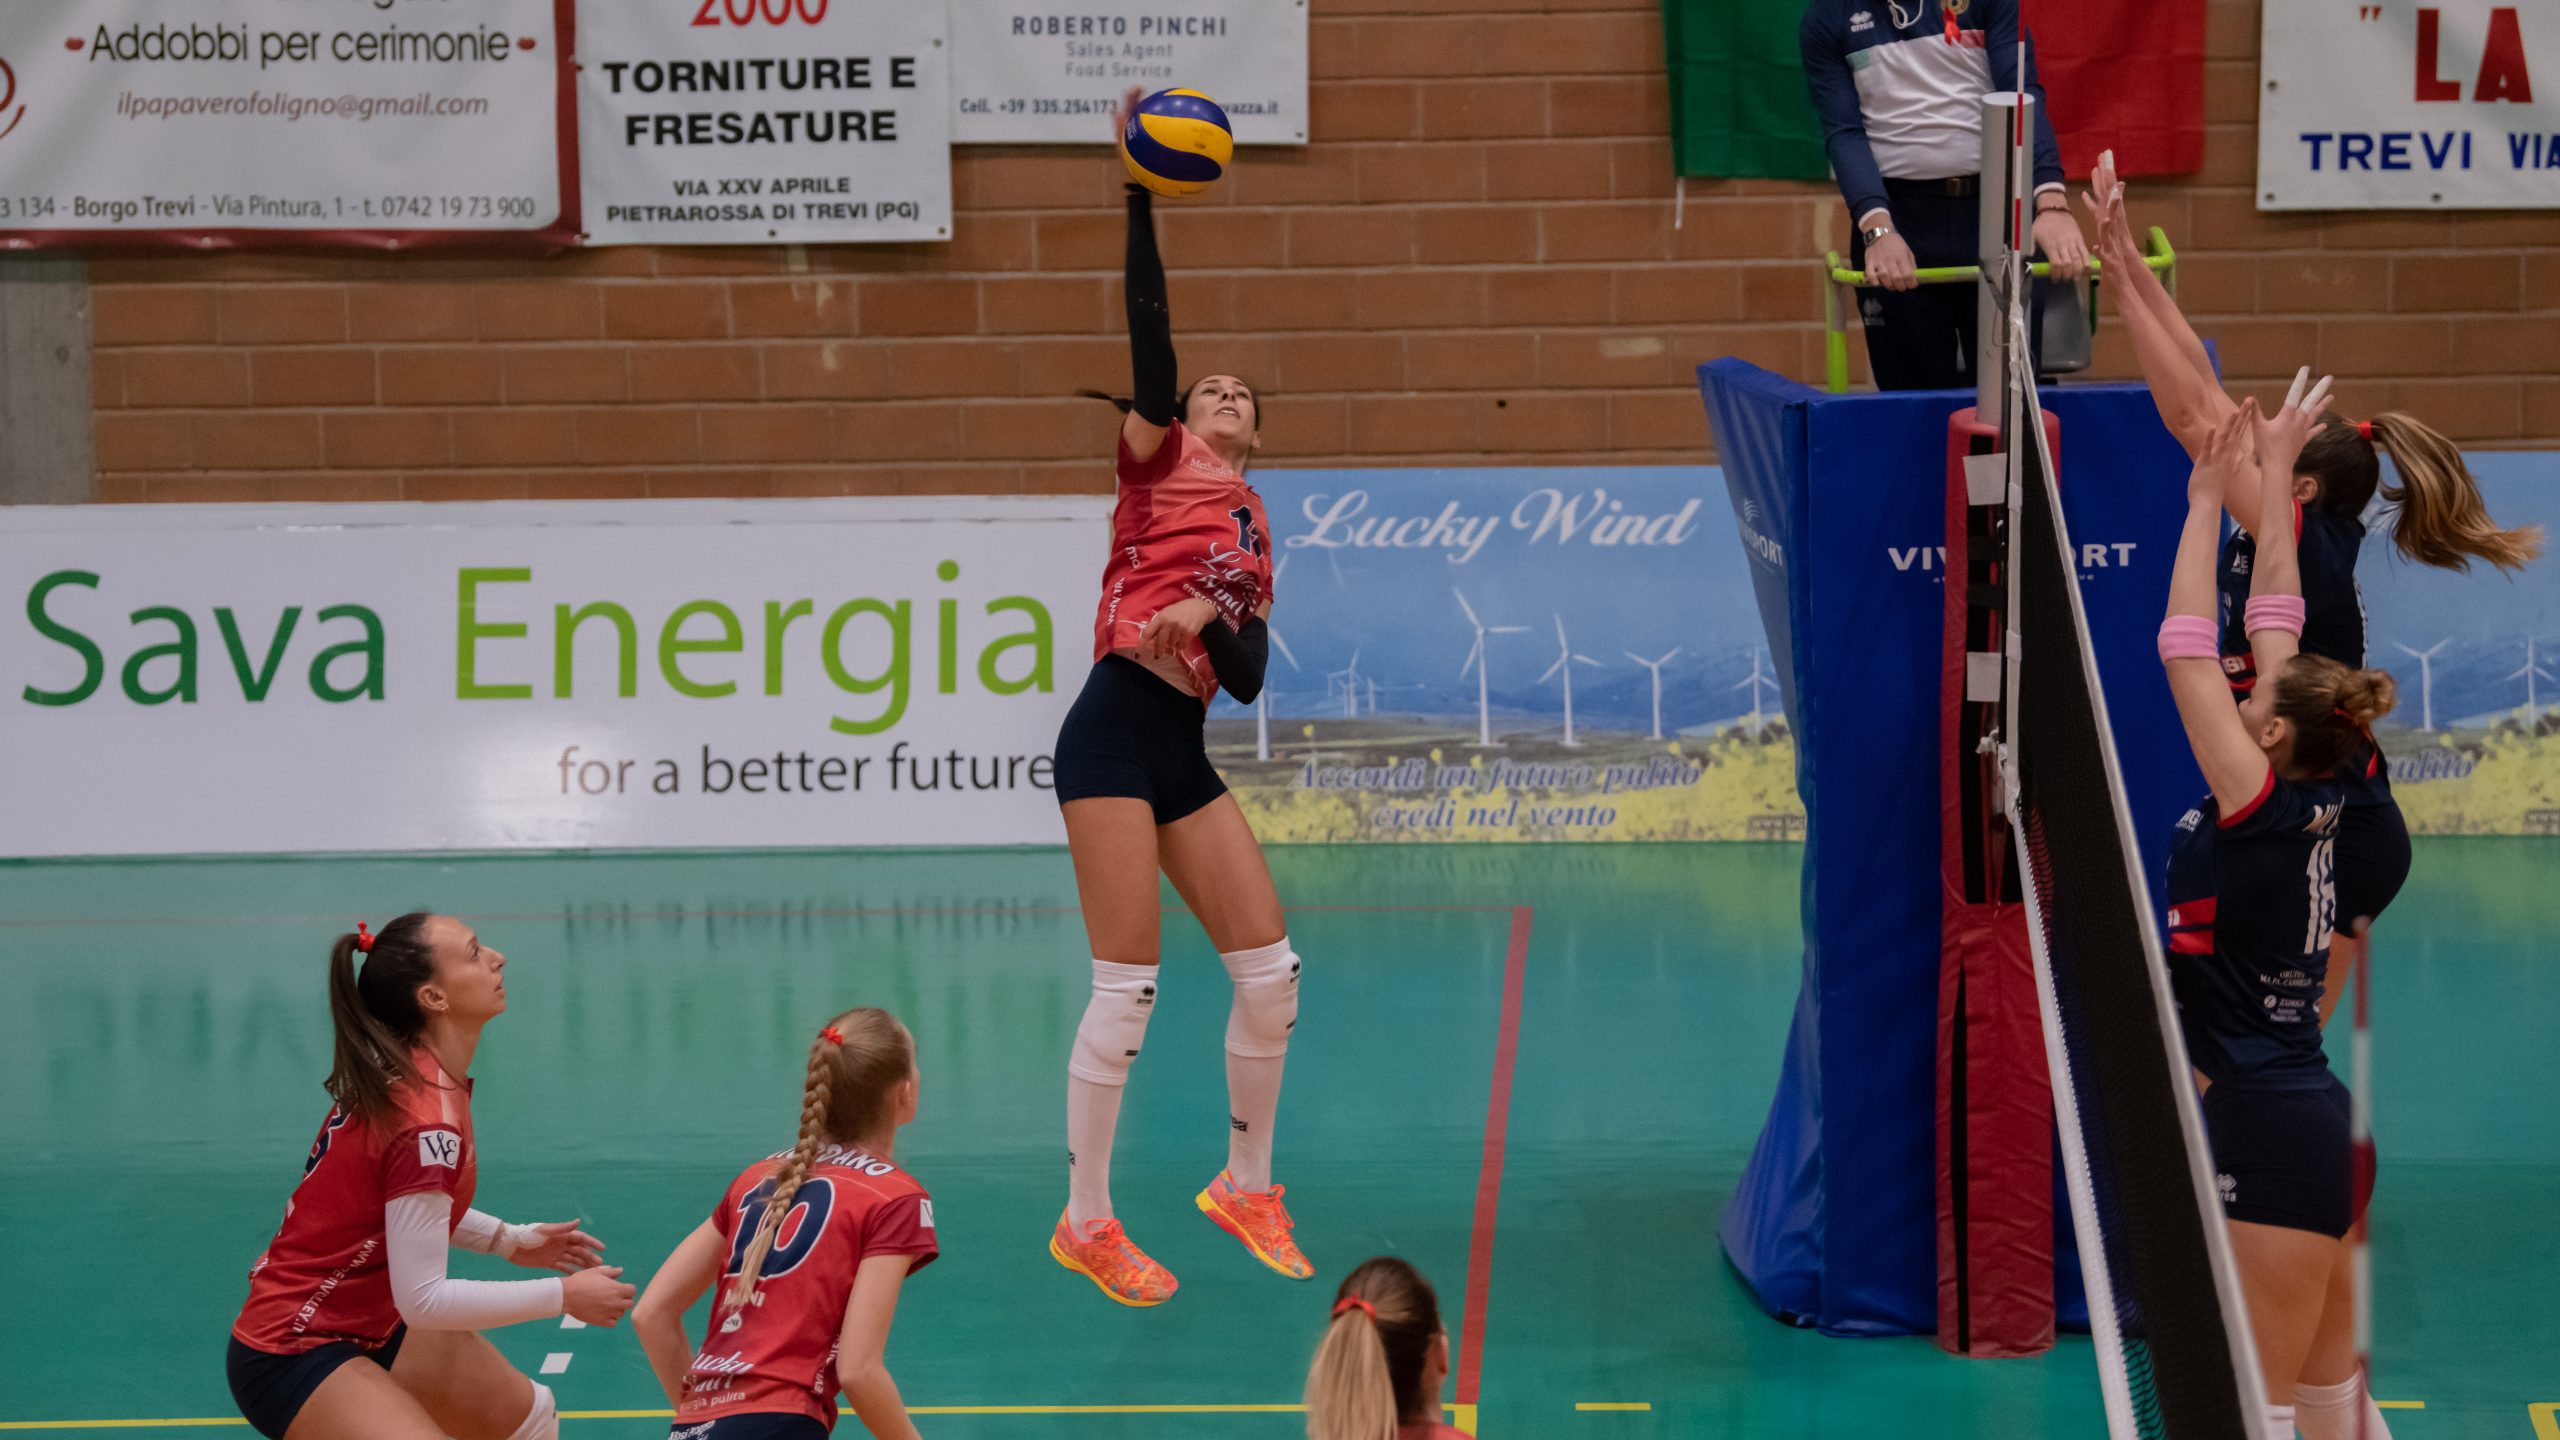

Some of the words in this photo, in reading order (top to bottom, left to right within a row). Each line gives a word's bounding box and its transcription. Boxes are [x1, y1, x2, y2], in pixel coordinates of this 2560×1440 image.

[1013, 16, 1127, 36] ROBERTO
[1140, 16, 1227, 36] PINCHI
[90, 23, 248, 62] Addobbi
[262, 32, 320, 69] per
[332, 24, 509, 62] cerimonie
[1066, 41, 1114, 57] Sales
[1122, 41, 1174, 59] Agent
[602, 57, 872, 94] TORNITURE
[890, 57, 916, 89] E
[1065, 62, 1104, 77] Food
[1113, 62, 1173, 77] Service
[117, 91, 489, 121] ilpapaverofoligno@gmail.com
[960, 99, 992, 114] Cell.
[999, 99, 1025, 114] +39
[1223, 101, 1280, 115] vazza.it
[626, 110, 898, 146] FRESATURE
[2299, 131, 2472, 171] TREVI
[2508, 132, 2560, 170] VIA
[673, 179, 709, 197] VIA
[717, 179, 763, 196] XXV
[770, 177, 851, 194] APRILE
[19, 197, 55, 217] 134
[74, 196, 138, 222] Borgo
[142, 195, 195, 217] Trevi
[212, 195, 243, 216] Via
[250, 195, 327, 219] Pintura,
[381, 196, 432, 217] 0742
[440, 196, 463, 217] 19
[468, 196, 492, 217] 73
[497, 196, 536, 217] 900
[606, 204, 764, 222] PIETRAROSSA
[773, 203, 795, 220] DI
[805, 202, 867, 220] TREVI
[875, 202, 919, 221] (PG)
[1285, 489, 1501, 564] Lucky
[1510, 488, 1702, 546] Wind
[22, 569, 386, 706] Sava
[456, 559, 1055, 735] Energia
[557, 745, 635, 795] for
[652, 758, 680, 794] a
[702, 744, 872, 794] better
[887, 742, 1055, 791] future
[1292, 758, 1426, 791] Accendi
[1434, 763, 1478, 789] un
[1486, 757, 1595, 795] futuro
[1601, 755, 1701, 795] pulito
[1374, 799, 1457, 829] credi
[1466, 799, 1519, 829] nel
[1529, 800, 1617, 829] vento
[723, 1175, 836, 1281] 10
